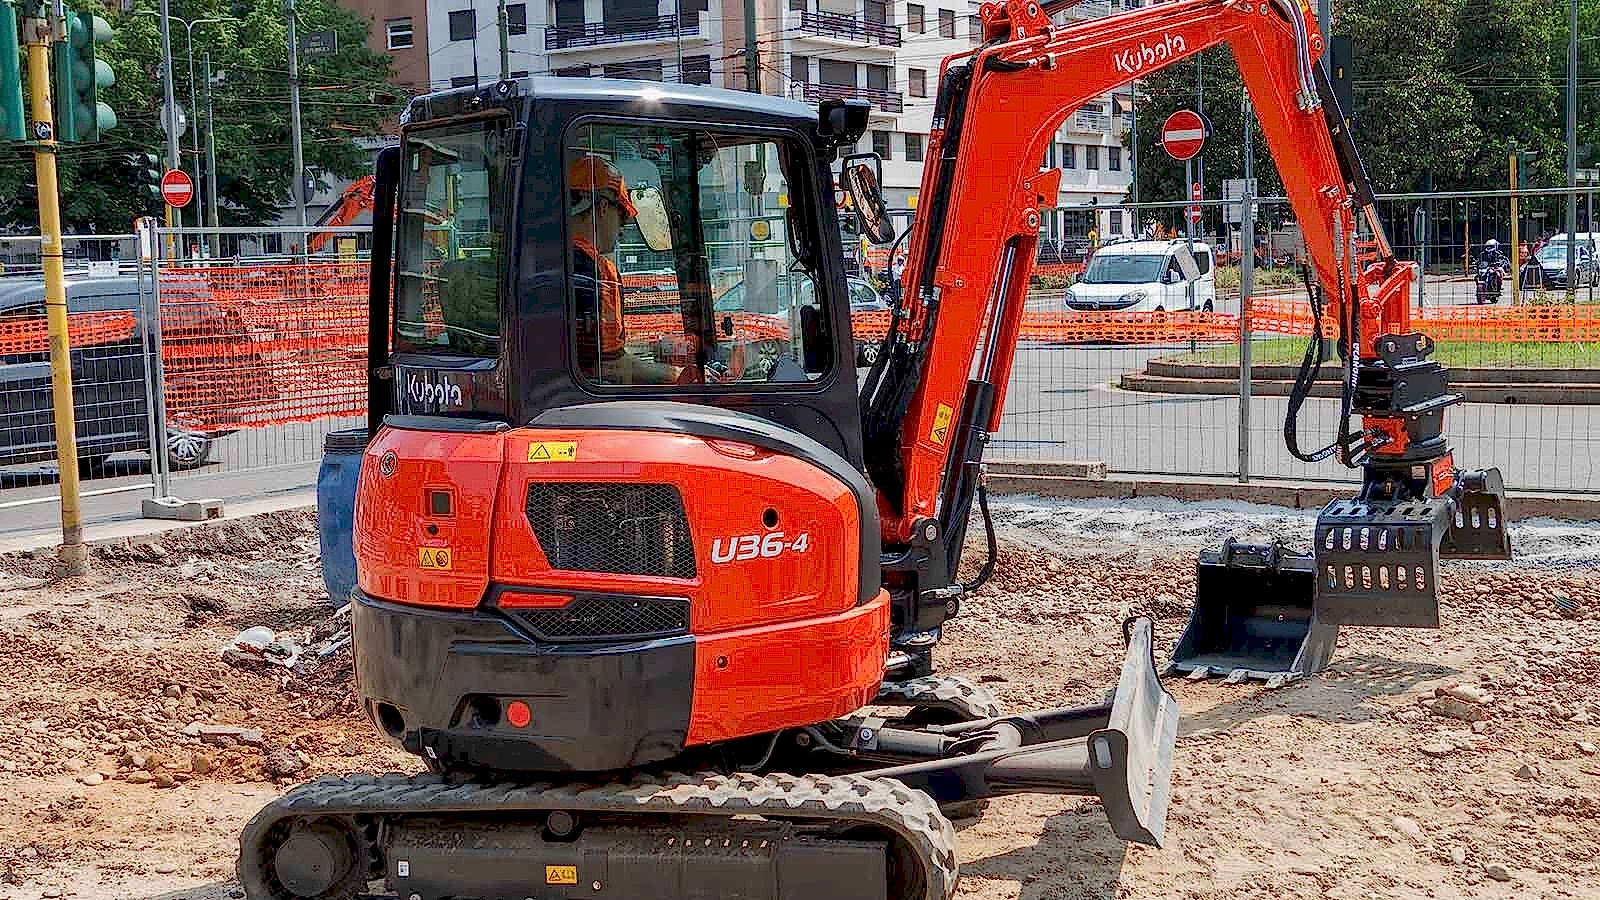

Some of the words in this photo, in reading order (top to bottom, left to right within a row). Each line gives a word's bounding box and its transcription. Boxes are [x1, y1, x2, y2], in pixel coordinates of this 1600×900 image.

[1114, 33, 1186, 73] Kubota
[407, 373, 463, 406] Kubota
[712, 532, 809, 564] U36-4
